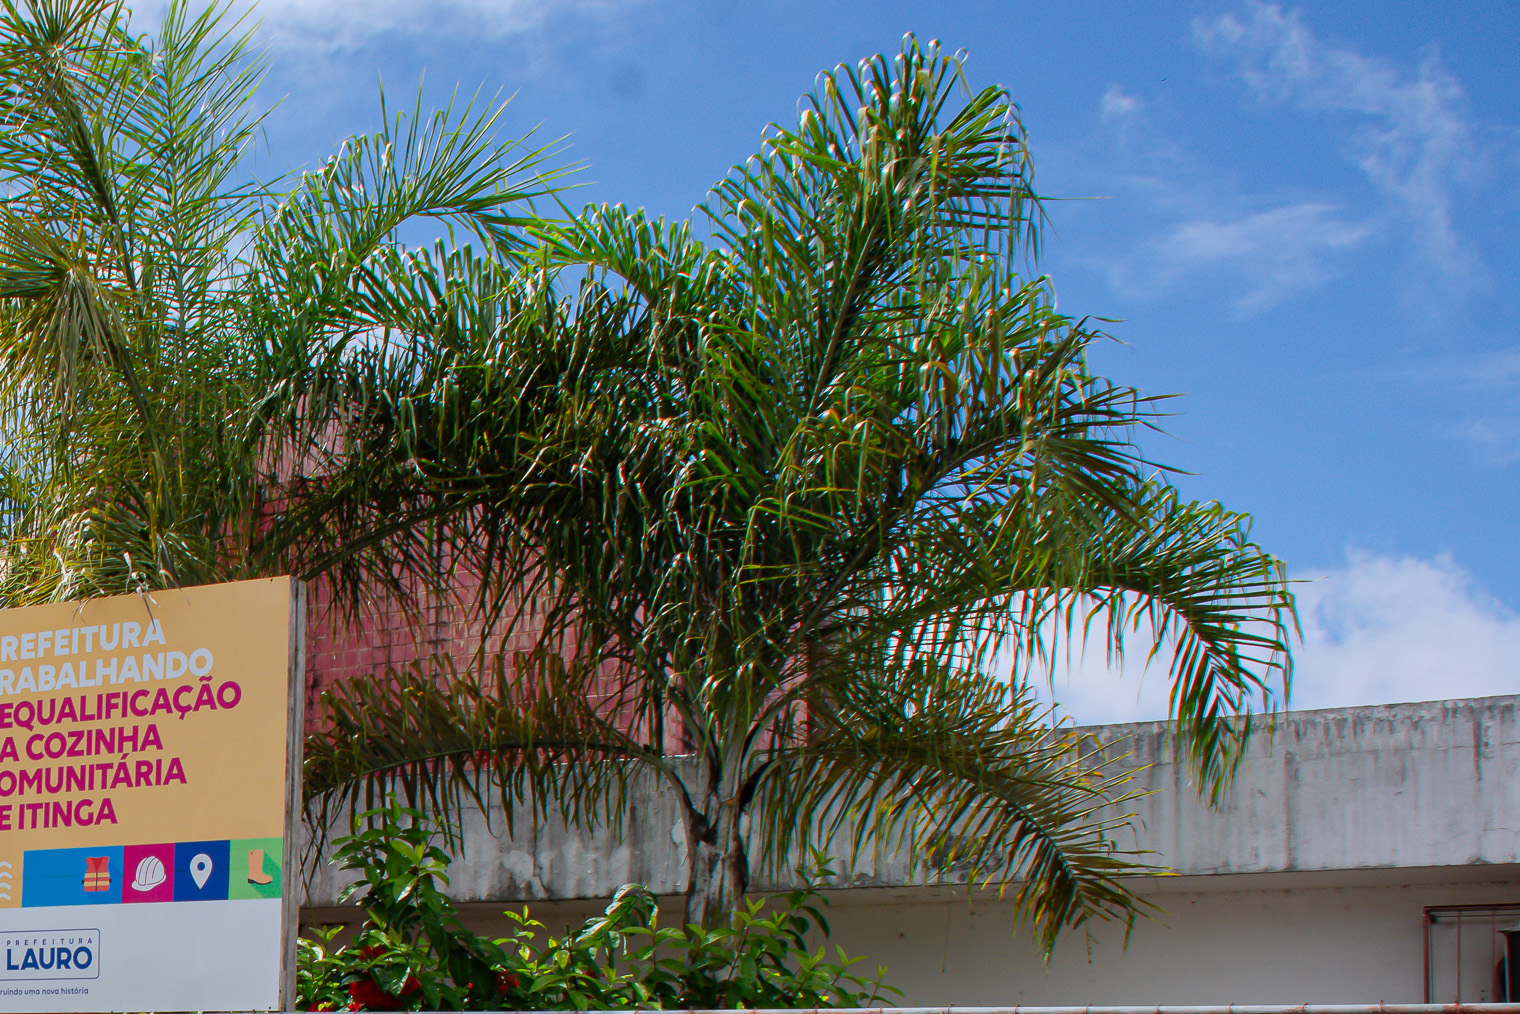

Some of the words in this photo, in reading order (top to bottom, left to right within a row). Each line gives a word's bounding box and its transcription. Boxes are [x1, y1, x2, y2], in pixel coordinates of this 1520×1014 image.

[26, 723, 164, 761] COZINHA
[18, 798, 118, 830] ITINGA
[6, 937, 93, 946] PREFEITURA
[6, 946, 93, 970] LAURO
[61, 987, 89, 995] história
